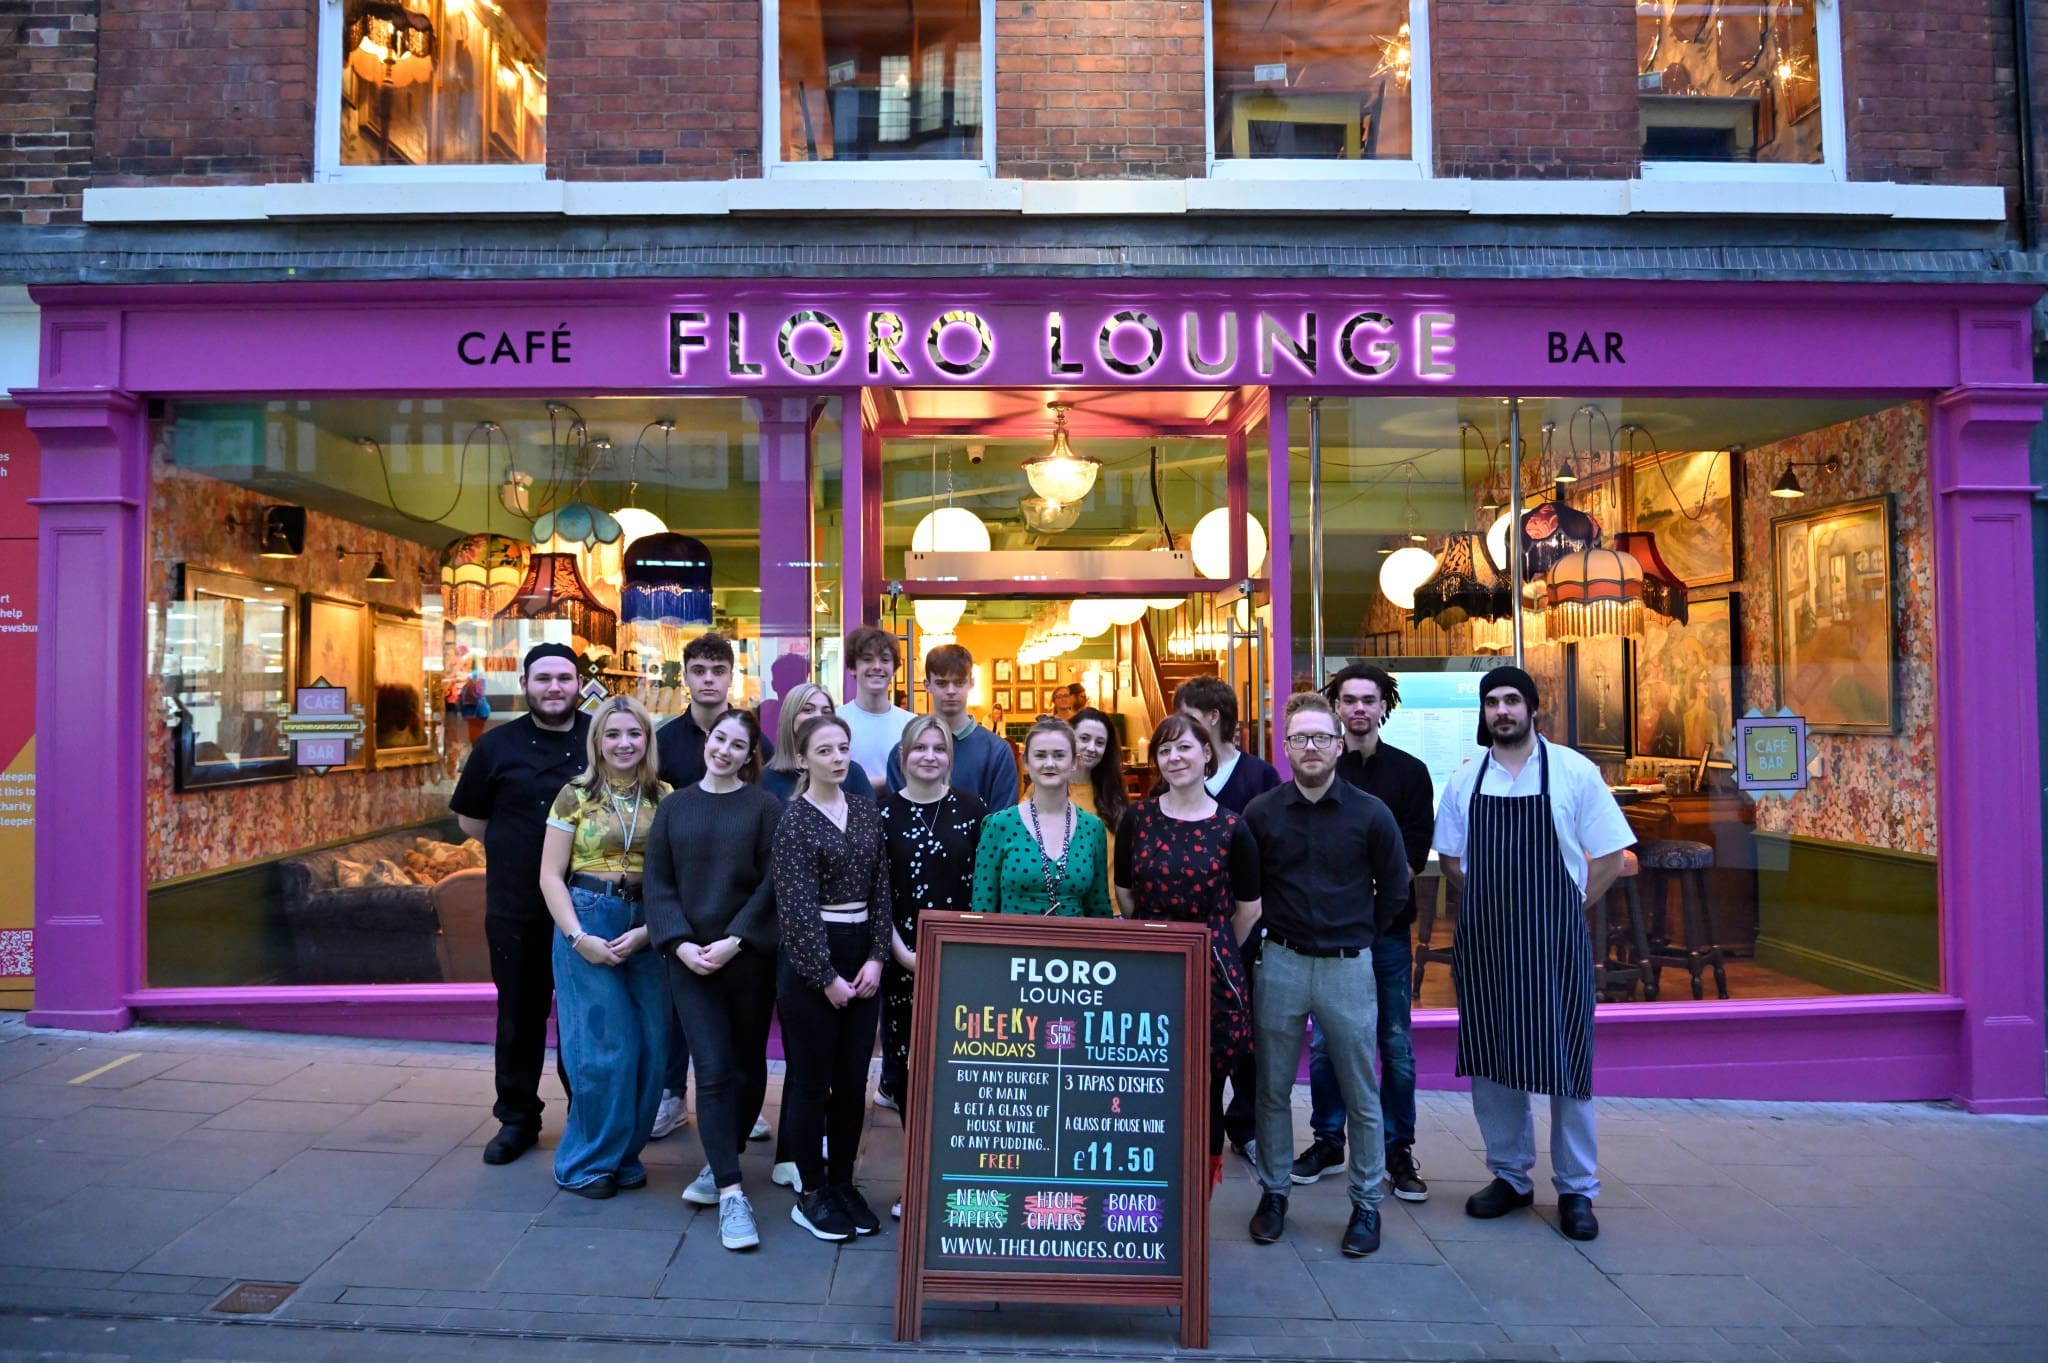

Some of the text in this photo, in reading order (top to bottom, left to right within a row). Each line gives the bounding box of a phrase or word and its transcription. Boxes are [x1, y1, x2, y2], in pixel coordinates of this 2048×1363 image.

[457, 322, 571, 365] CAFÉ
[669, 309, 1456, 377] FLORO LOUNGE
[1548, 331, 1626, 364] BAR
[0, 608, 23, 620] help
[307, 744, 334, 760] BAR
[1755, 736, 1788, 753] CAFÉ
[1759, 756, 1784, 770] BAR
[4, 787, 24, 796] this
[0, 816, 36, 828] leeper
[1010, 957, 1117, 986] FLORO
[1020, 987, 1103, 1006] LOUNGE
[954, 1004, 1039, 1041] CHEEKY
[1083, 1010, 1169, 1047] TAPAS
[952, 1041, 1036, 1058] MONDAYS
[1085, 1046, 1168, 1063] TUESDAYS
[957, 1069, 1050, 1085] BUY ANY BURGER
[1064, 1074, 1164, 1094] 3 TAPAS DISHES
[978, 1086, 1027, 1101] OR MAIN
[953, 1101, 1051, 1118] & GET A GLASS OF
[1111, 1096, 1121, 1114] &
[966, 1119, 1036, 1134] HOUSE WINE
[1065, 1116, 1166, 1134] A GLASS OF HOUSE WINE
[950, 1135, 1050, 1151] OR ANY PUDDING..
[979, 1152, 1020, 1170] FREE!
[956, 1188, 999, 1207] NEWS
[1037, 1191, 1074, 1210] HIGH
[1109, 1193, 1157, 1212] BOARD
[949, 1210, 1004, 1229] PAPERS
[1027, 1212, 1082, 1231] CHAIRS
[1107, 1214, 1159, 1233] GAMES
[941, 1236, 1166, 1260] WWW.THELOUNGES.CO.UK
